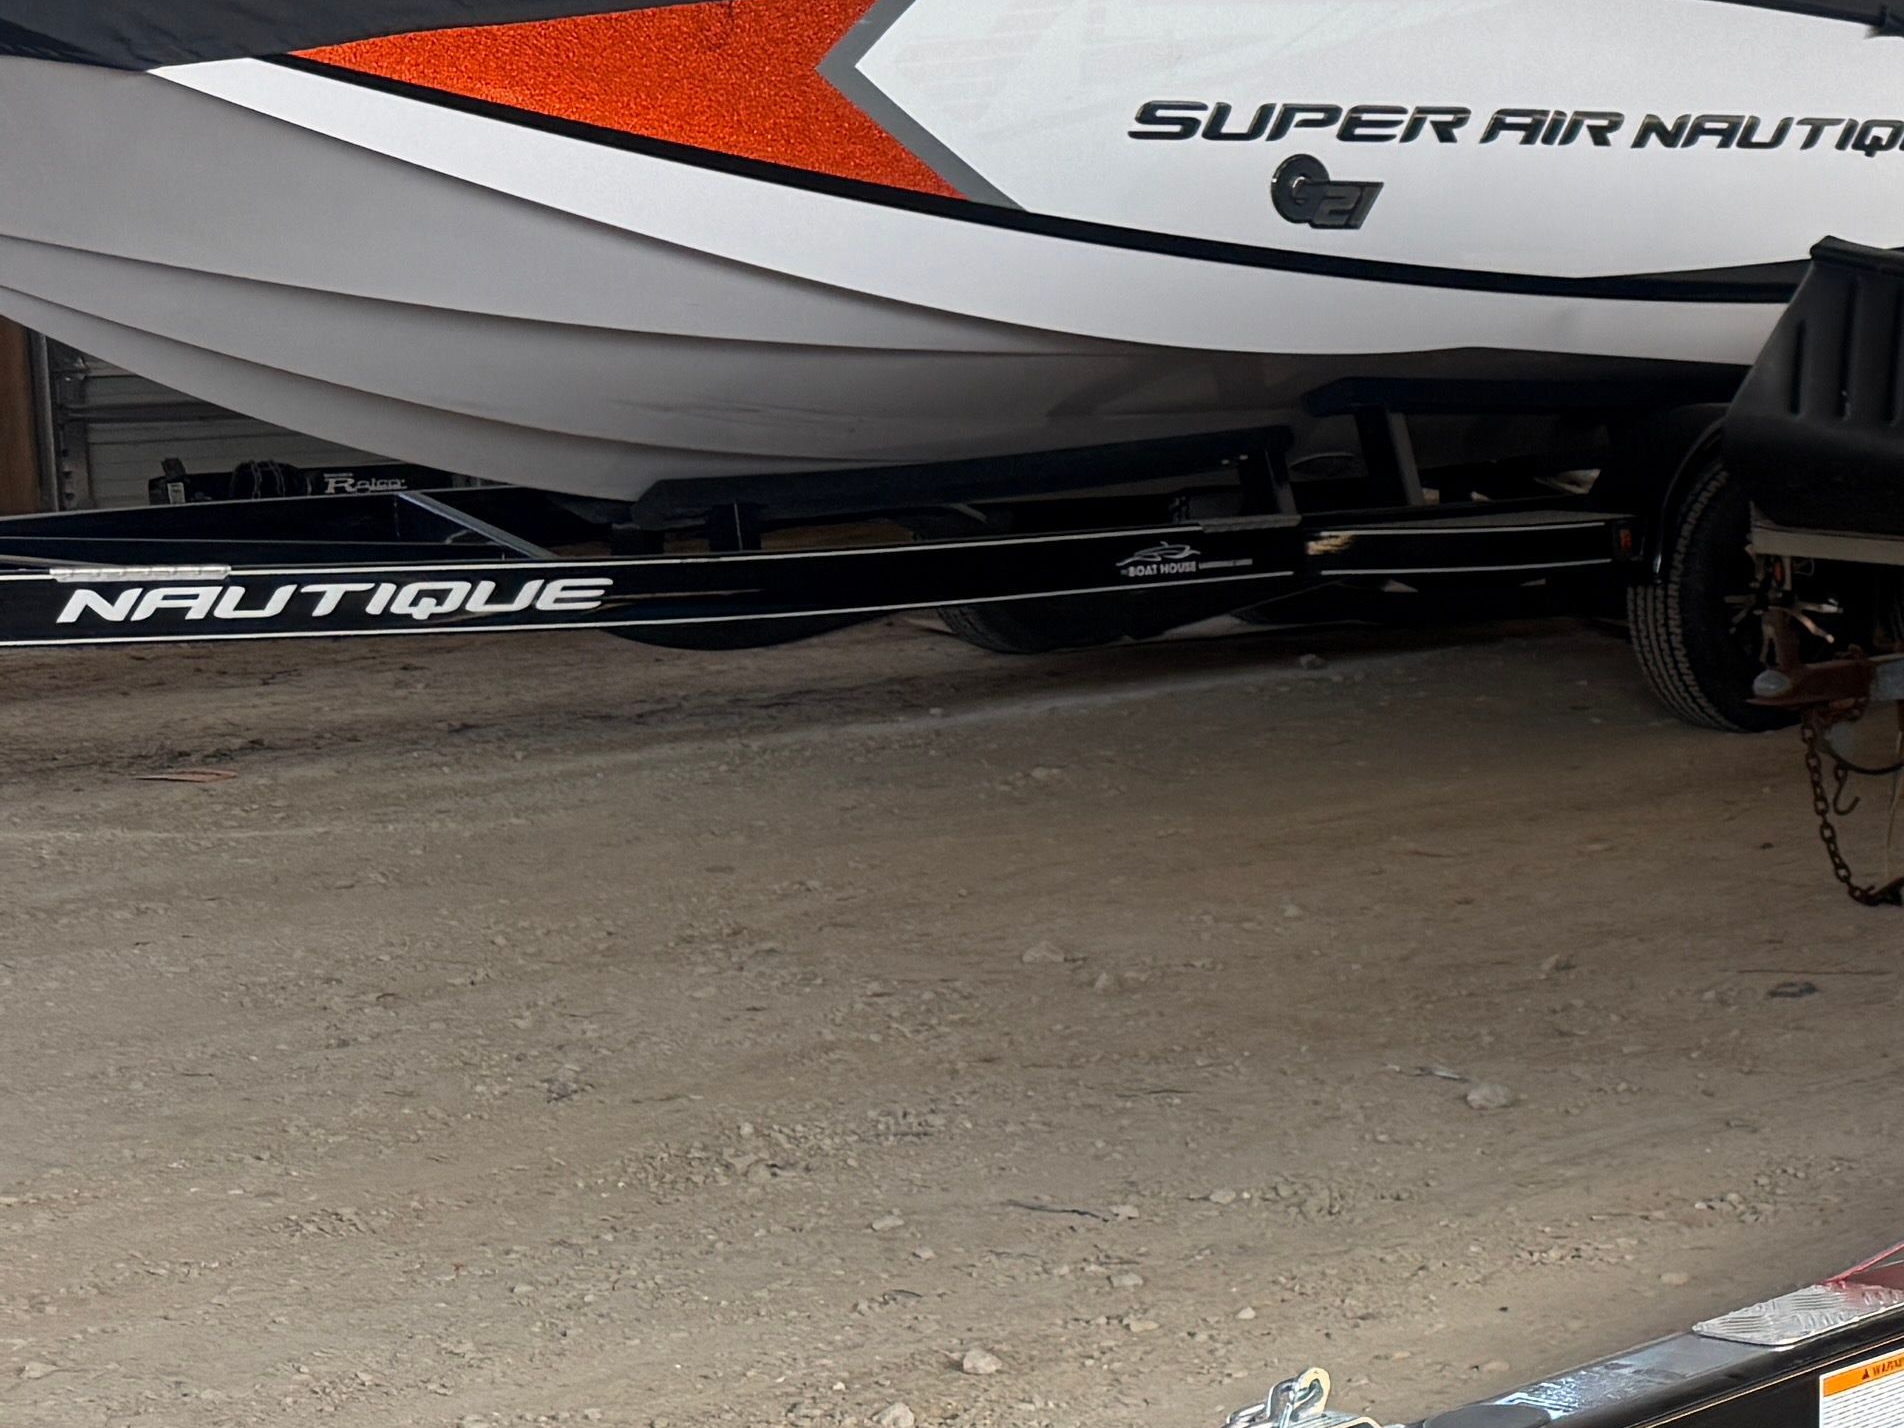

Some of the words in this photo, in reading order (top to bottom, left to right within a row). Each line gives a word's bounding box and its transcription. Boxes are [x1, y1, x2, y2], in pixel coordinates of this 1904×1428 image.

[1127, 100, 1472, 145] SUPER
[1479, 108, 1626, 146] AIR
[57, 578, 614, 623] NAUTIQUE
